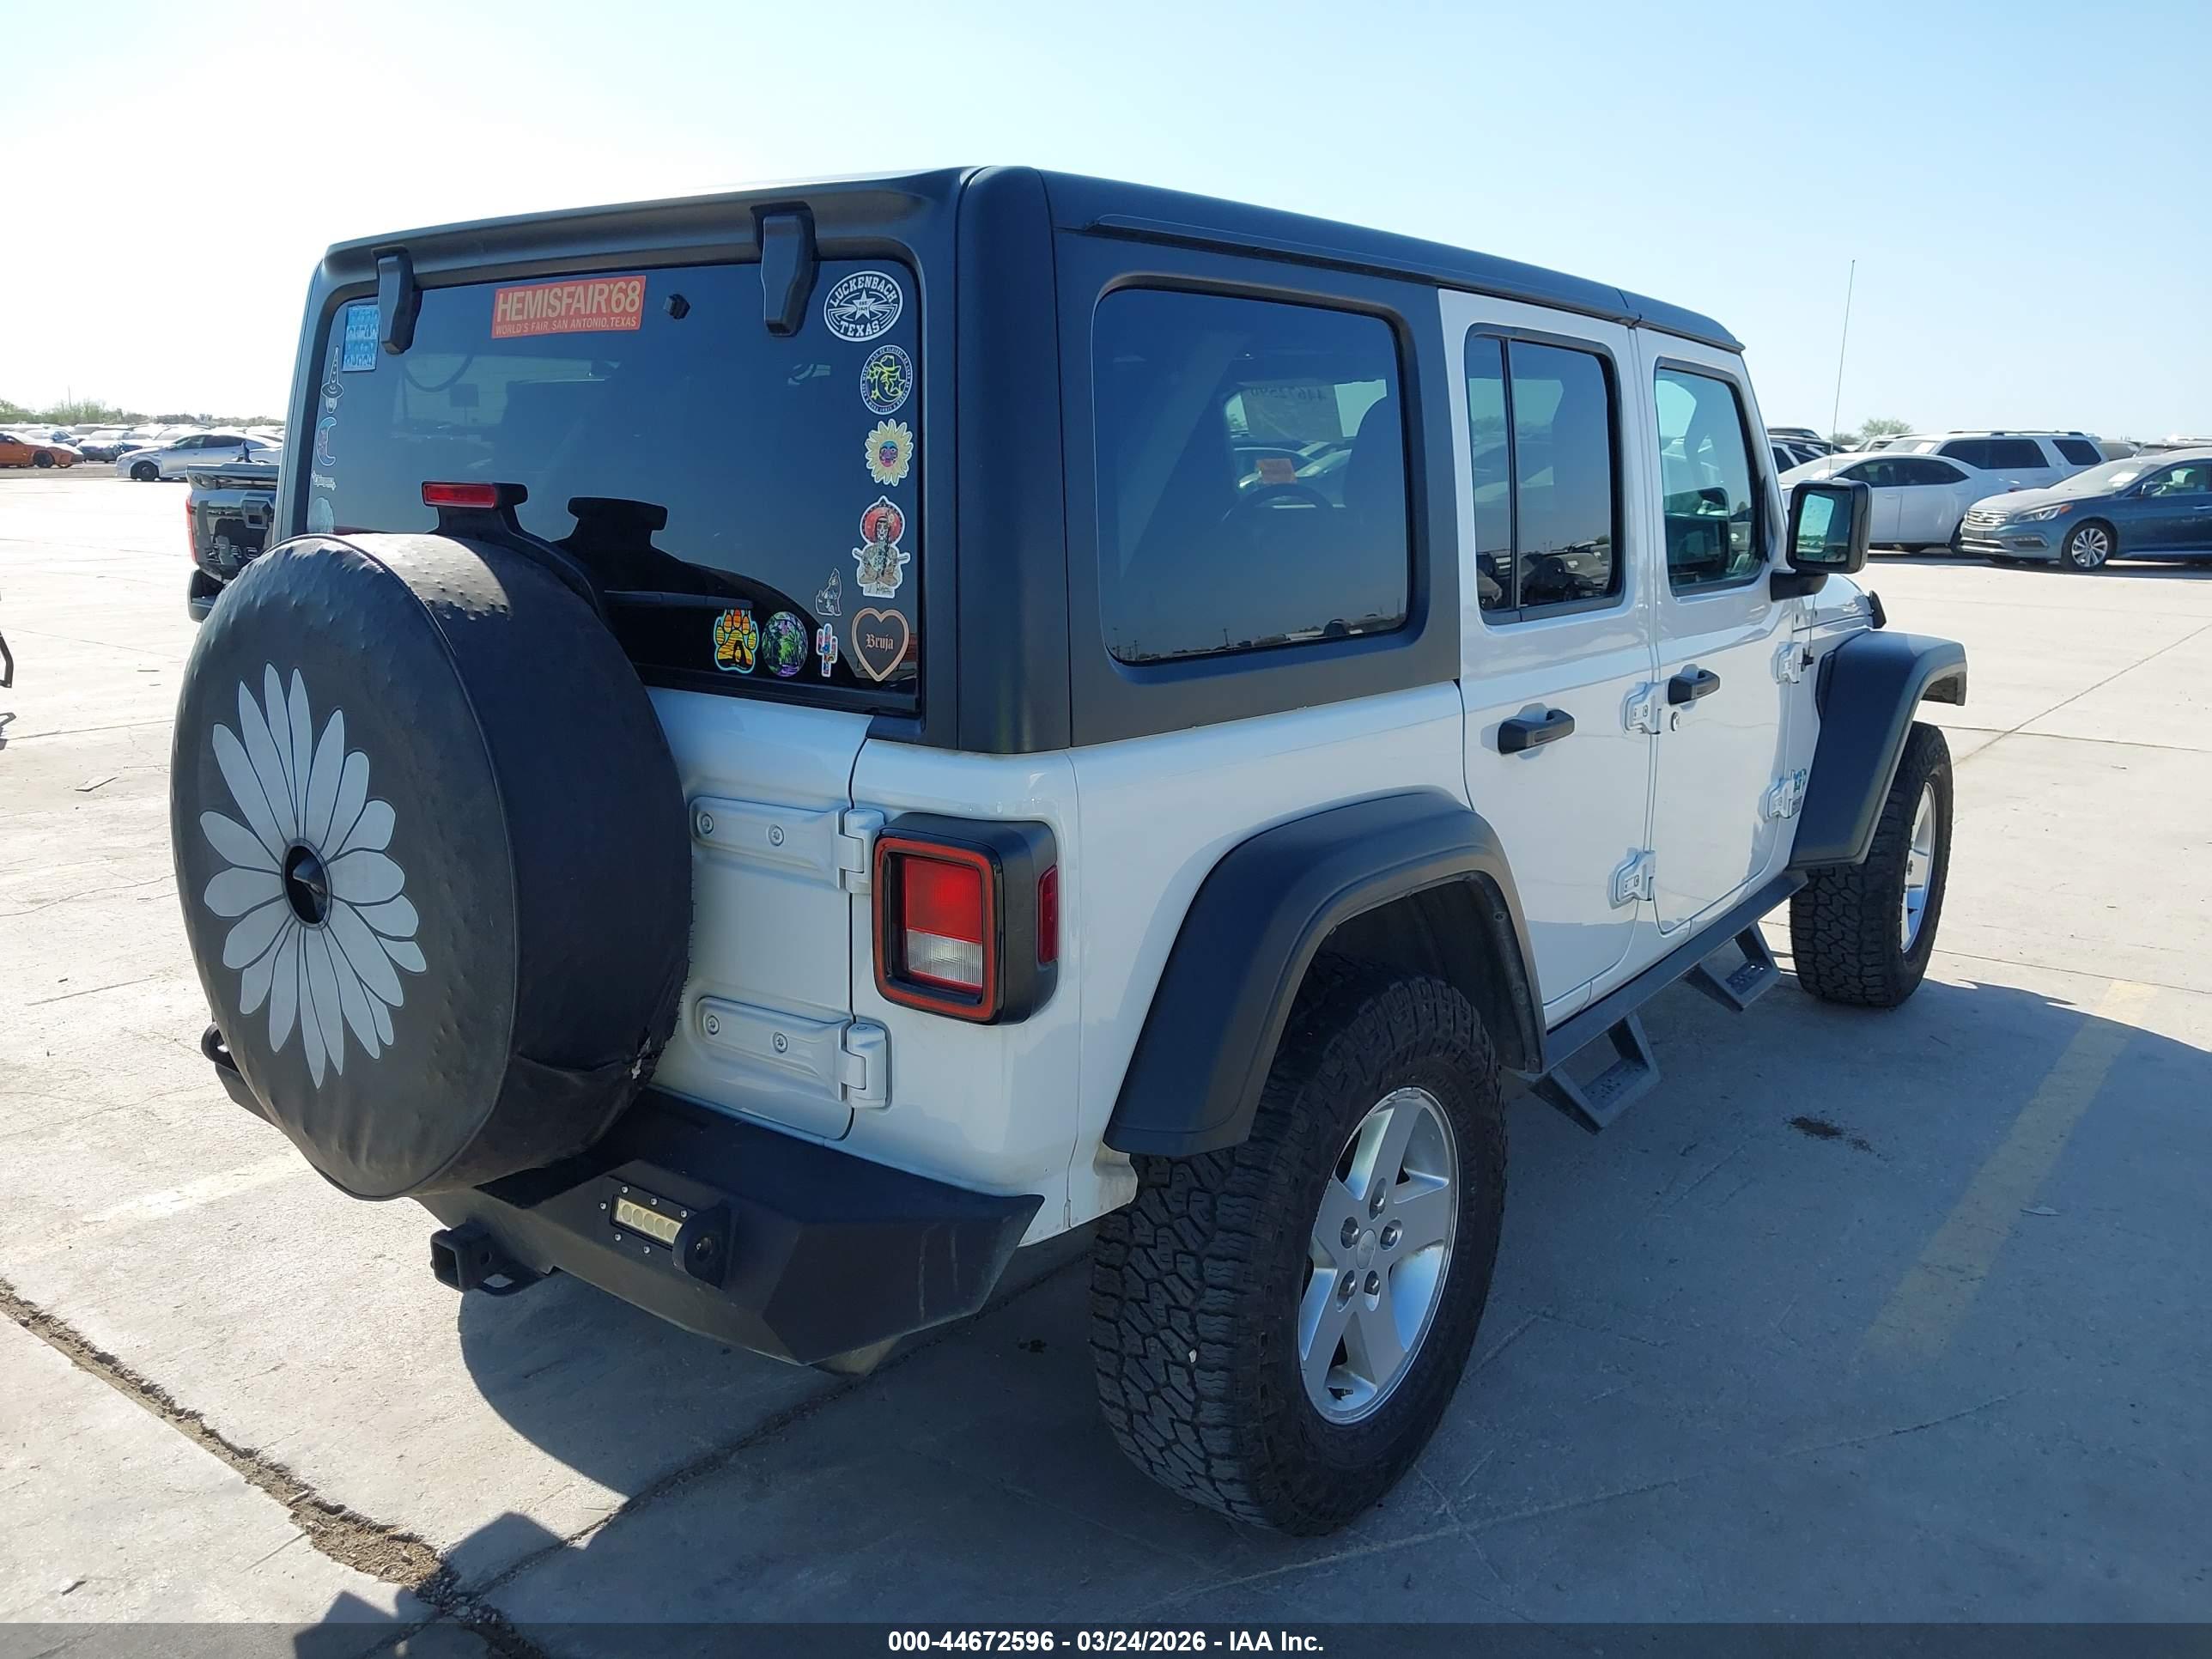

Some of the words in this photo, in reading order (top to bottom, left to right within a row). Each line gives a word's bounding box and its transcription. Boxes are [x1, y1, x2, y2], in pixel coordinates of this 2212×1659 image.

[830, 276, 897, 307] LUCKENBACH
[495, 321, 530, 336] WORLD'S
[551, 319, 568, 331] SAN
[610, 315, 637, 327] TEXAS
[839, 319, 880, 337] TEXAS
[865, 633, 894, 653] Bruja
